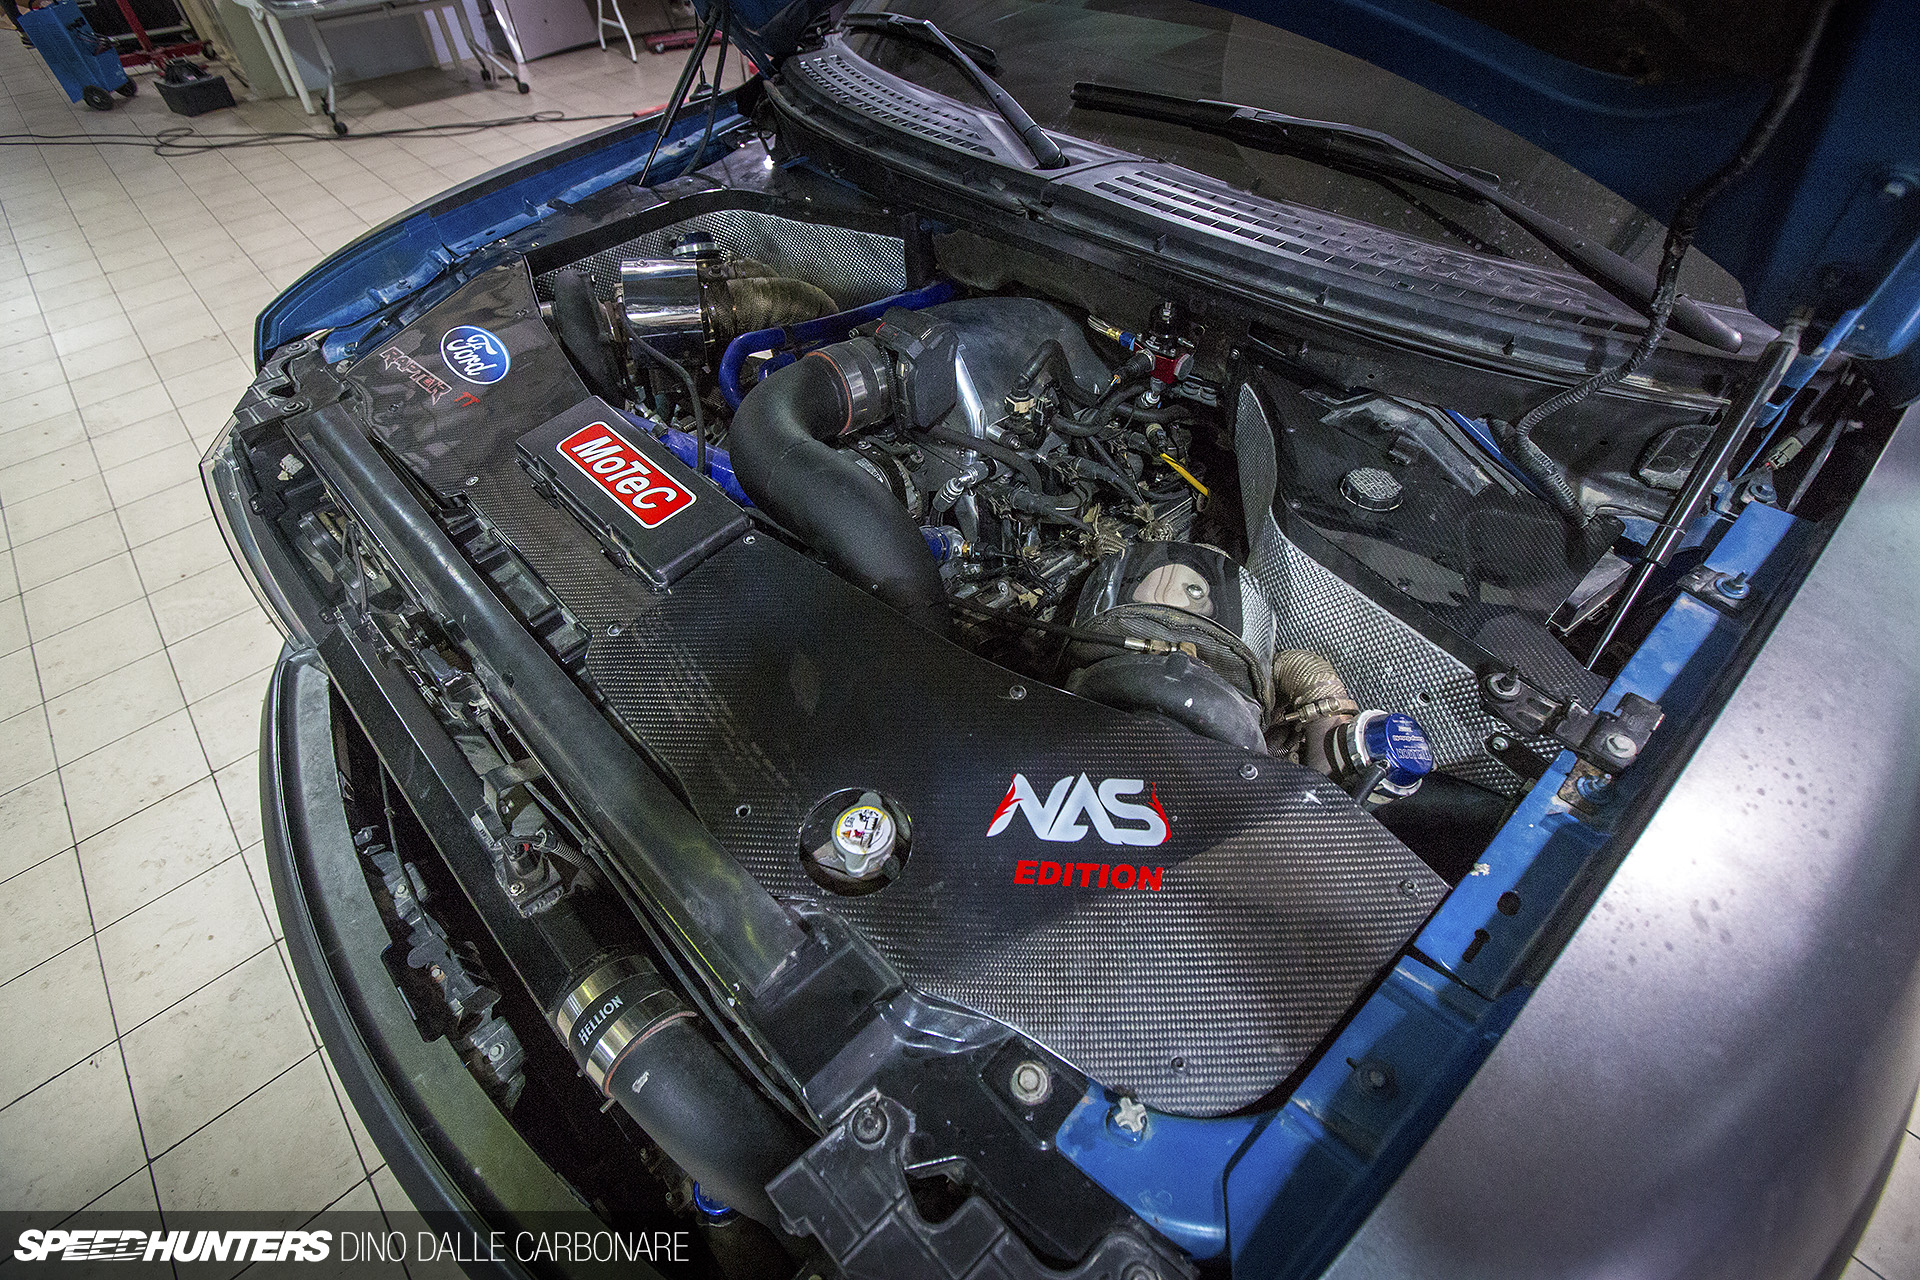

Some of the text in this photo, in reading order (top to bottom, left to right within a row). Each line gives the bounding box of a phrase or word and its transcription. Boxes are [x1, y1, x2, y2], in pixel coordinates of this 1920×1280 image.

[447, 334, 498, 376] Ford
[570, 435, 678, 509] MoTeC
[986, 772, 1172, 847] NAS
[1013, 860, 1164, 892] EDITION
[577, 995, 624, 1046] HELLION
